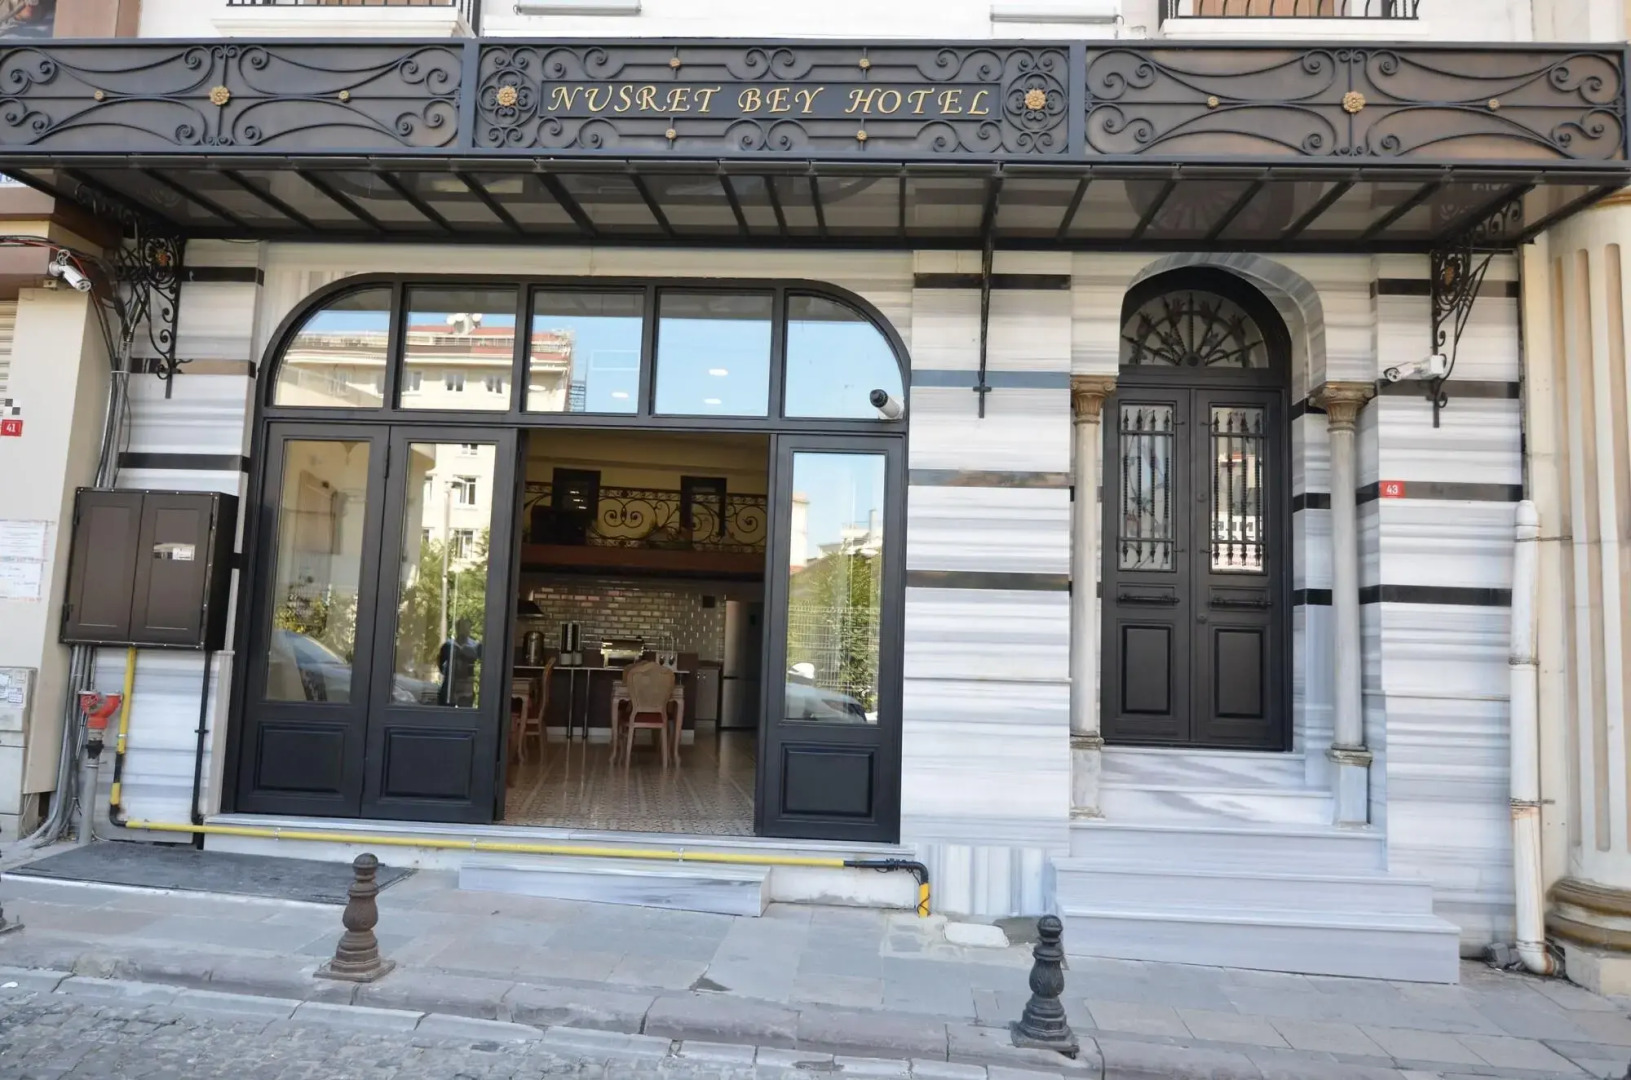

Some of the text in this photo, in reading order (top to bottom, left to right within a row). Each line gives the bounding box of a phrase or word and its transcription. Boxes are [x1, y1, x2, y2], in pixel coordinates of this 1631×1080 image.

[547, 85, 989, 115] NUSRET BEY HOTEL
[6, 423, 16, 433] 41
[1386, 484, 1398, 496] 43
